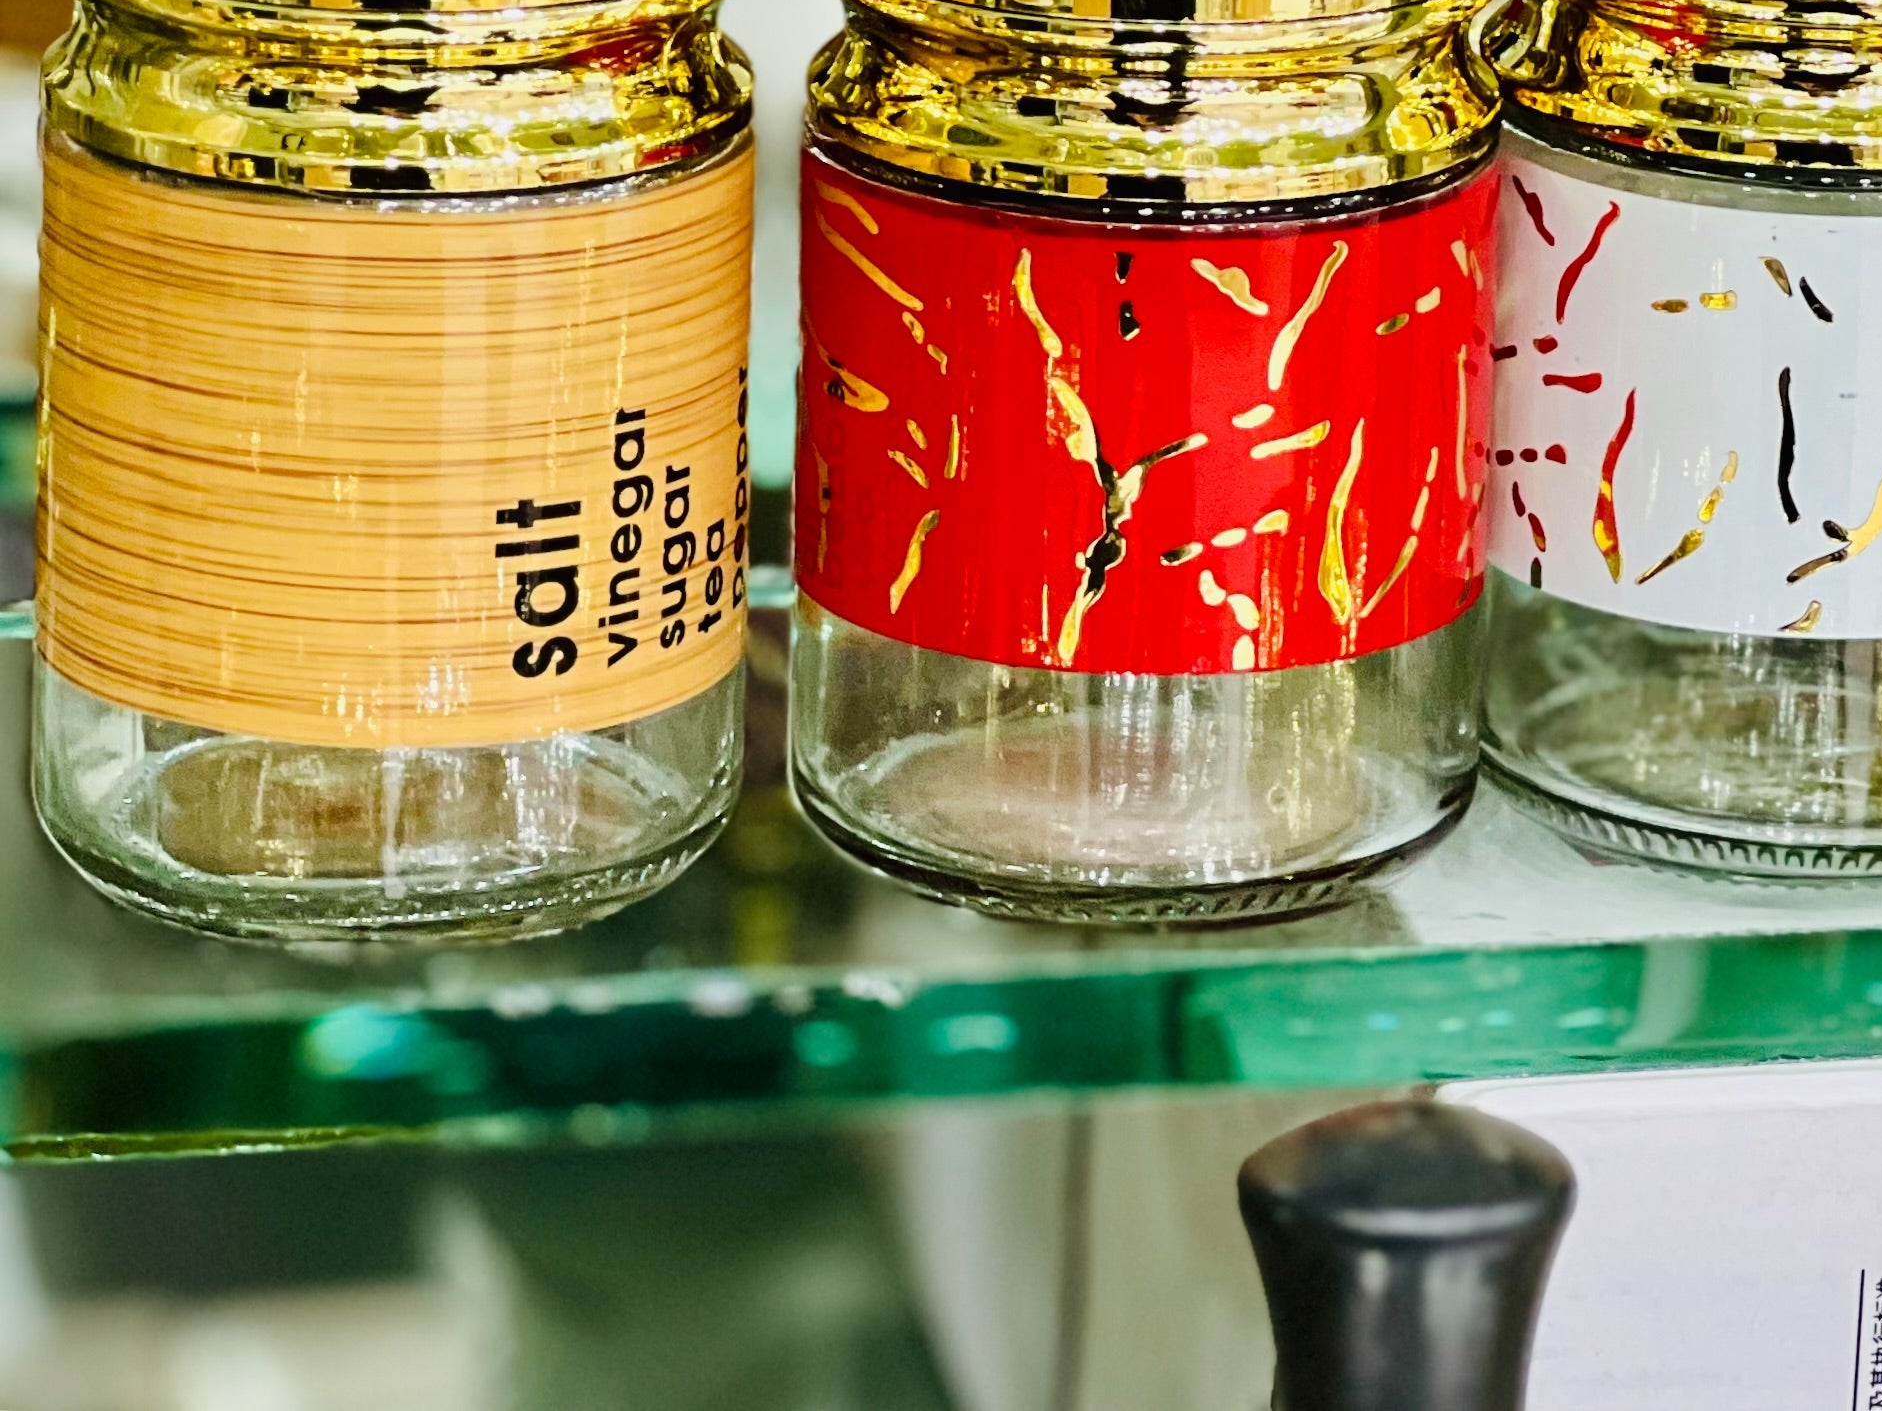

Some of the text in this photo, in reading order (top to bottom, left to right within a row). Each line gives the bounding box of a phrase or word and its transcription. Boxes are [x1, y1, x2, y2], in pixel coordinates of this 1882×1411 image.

[496, 498, 582, 678] salt
[598, 406, 654, 668] vinegar
[660, 464, 697, 650] sugar
[697, 518, 726, 634] tea
